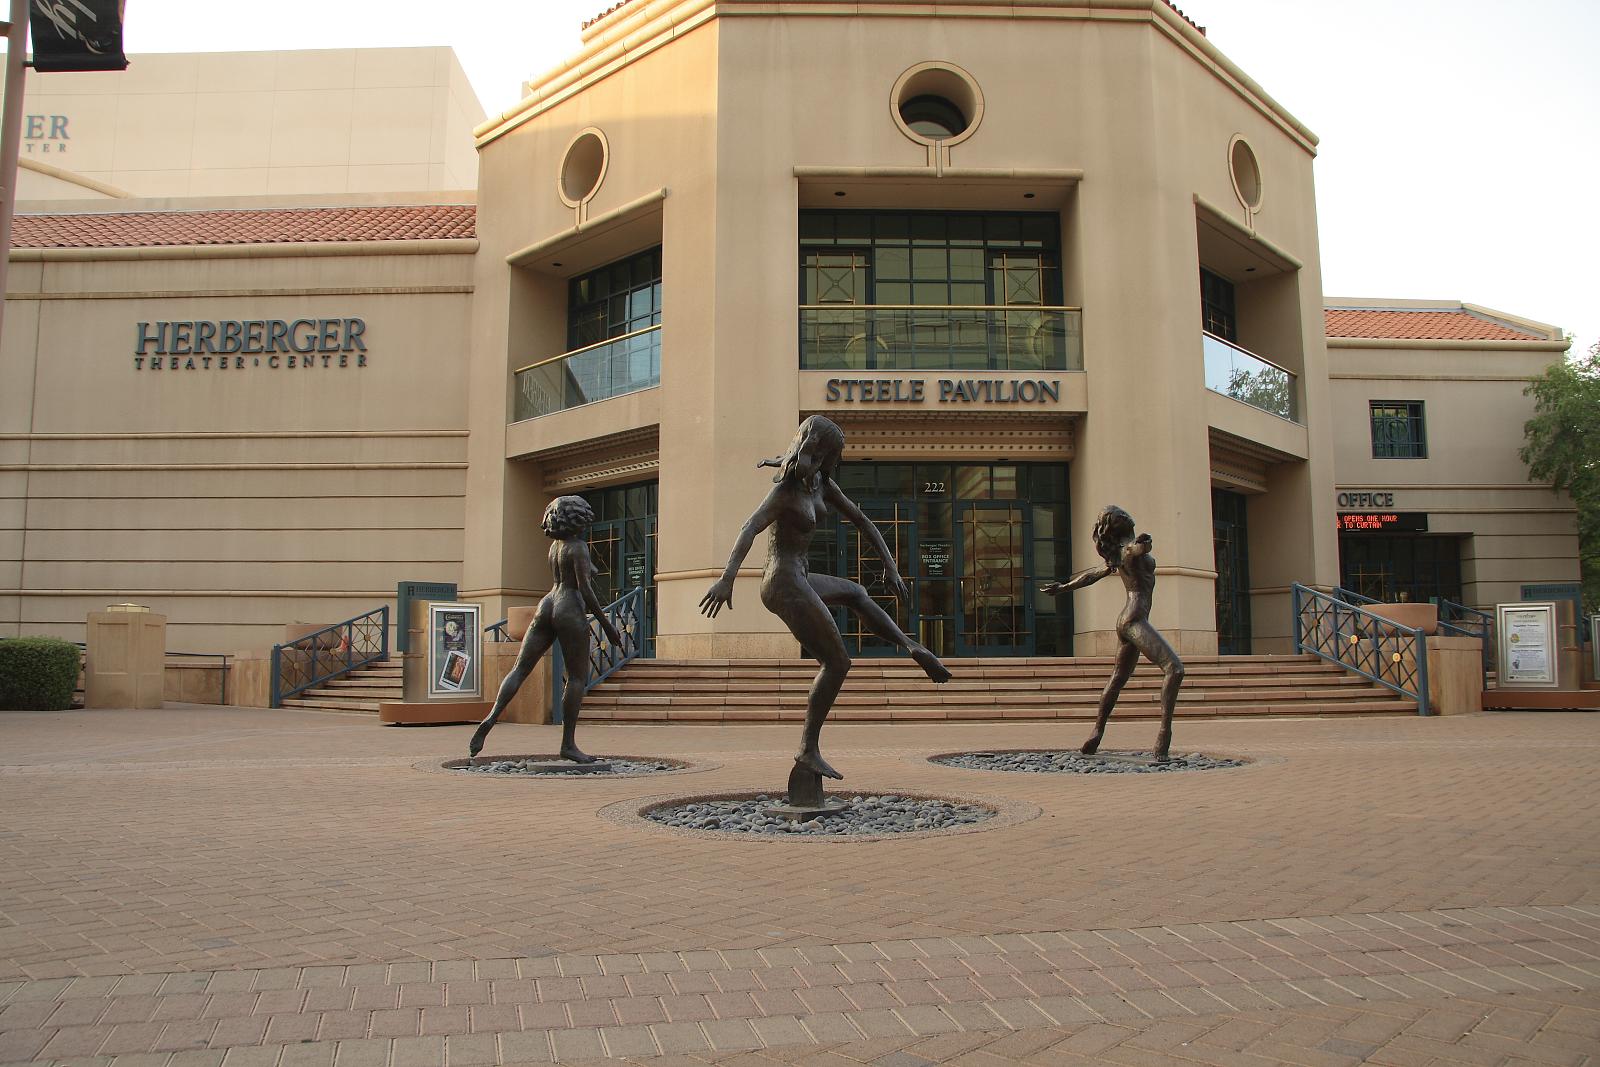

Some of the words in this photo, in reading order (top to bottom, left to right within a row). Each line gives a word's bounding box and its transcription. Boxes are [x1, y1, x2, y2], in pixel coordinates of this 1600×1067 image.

[24, 115, 70, 139] ER
[26, 143, 67, 153] TER
[136, 318, 368, 354] HERBERGER
[135, 356, 245, 370] THEATER
[268, 354, 368, 369] CENTER
[826, 378, 925, 403] STEELE
[938, 379, 1061, 404] PAVILION
[924, 482, 945, 493] 222
[1337, 492, 1394, 507] OFFICE
[1344, 521, 1356, 529] TO
